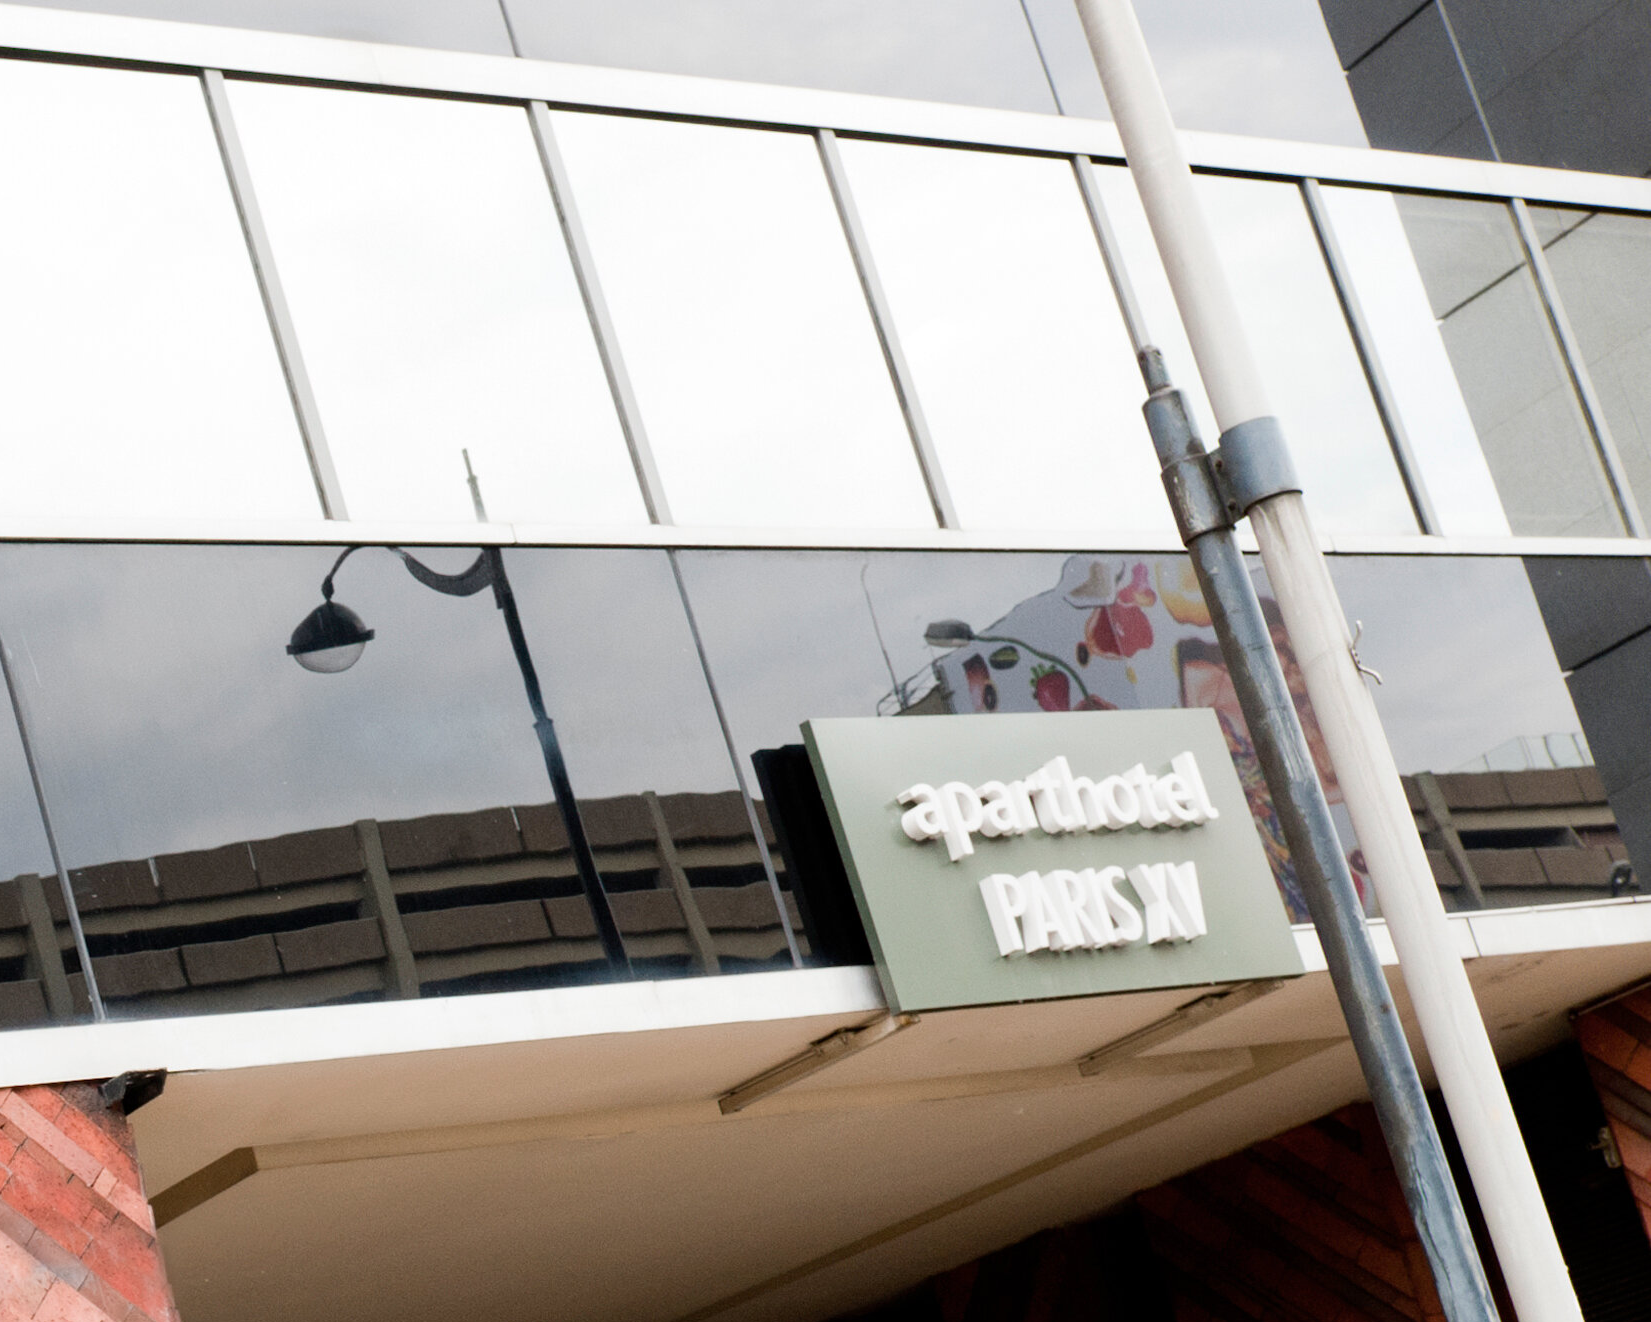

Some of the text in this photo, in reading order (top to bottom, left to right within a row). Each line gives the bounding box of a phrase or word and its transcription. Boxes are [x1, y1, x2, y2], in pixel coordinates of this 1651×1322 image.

[896, 751, 1220, 862] aparthotel
[978, 860, 1207, 957] PARIS XV
